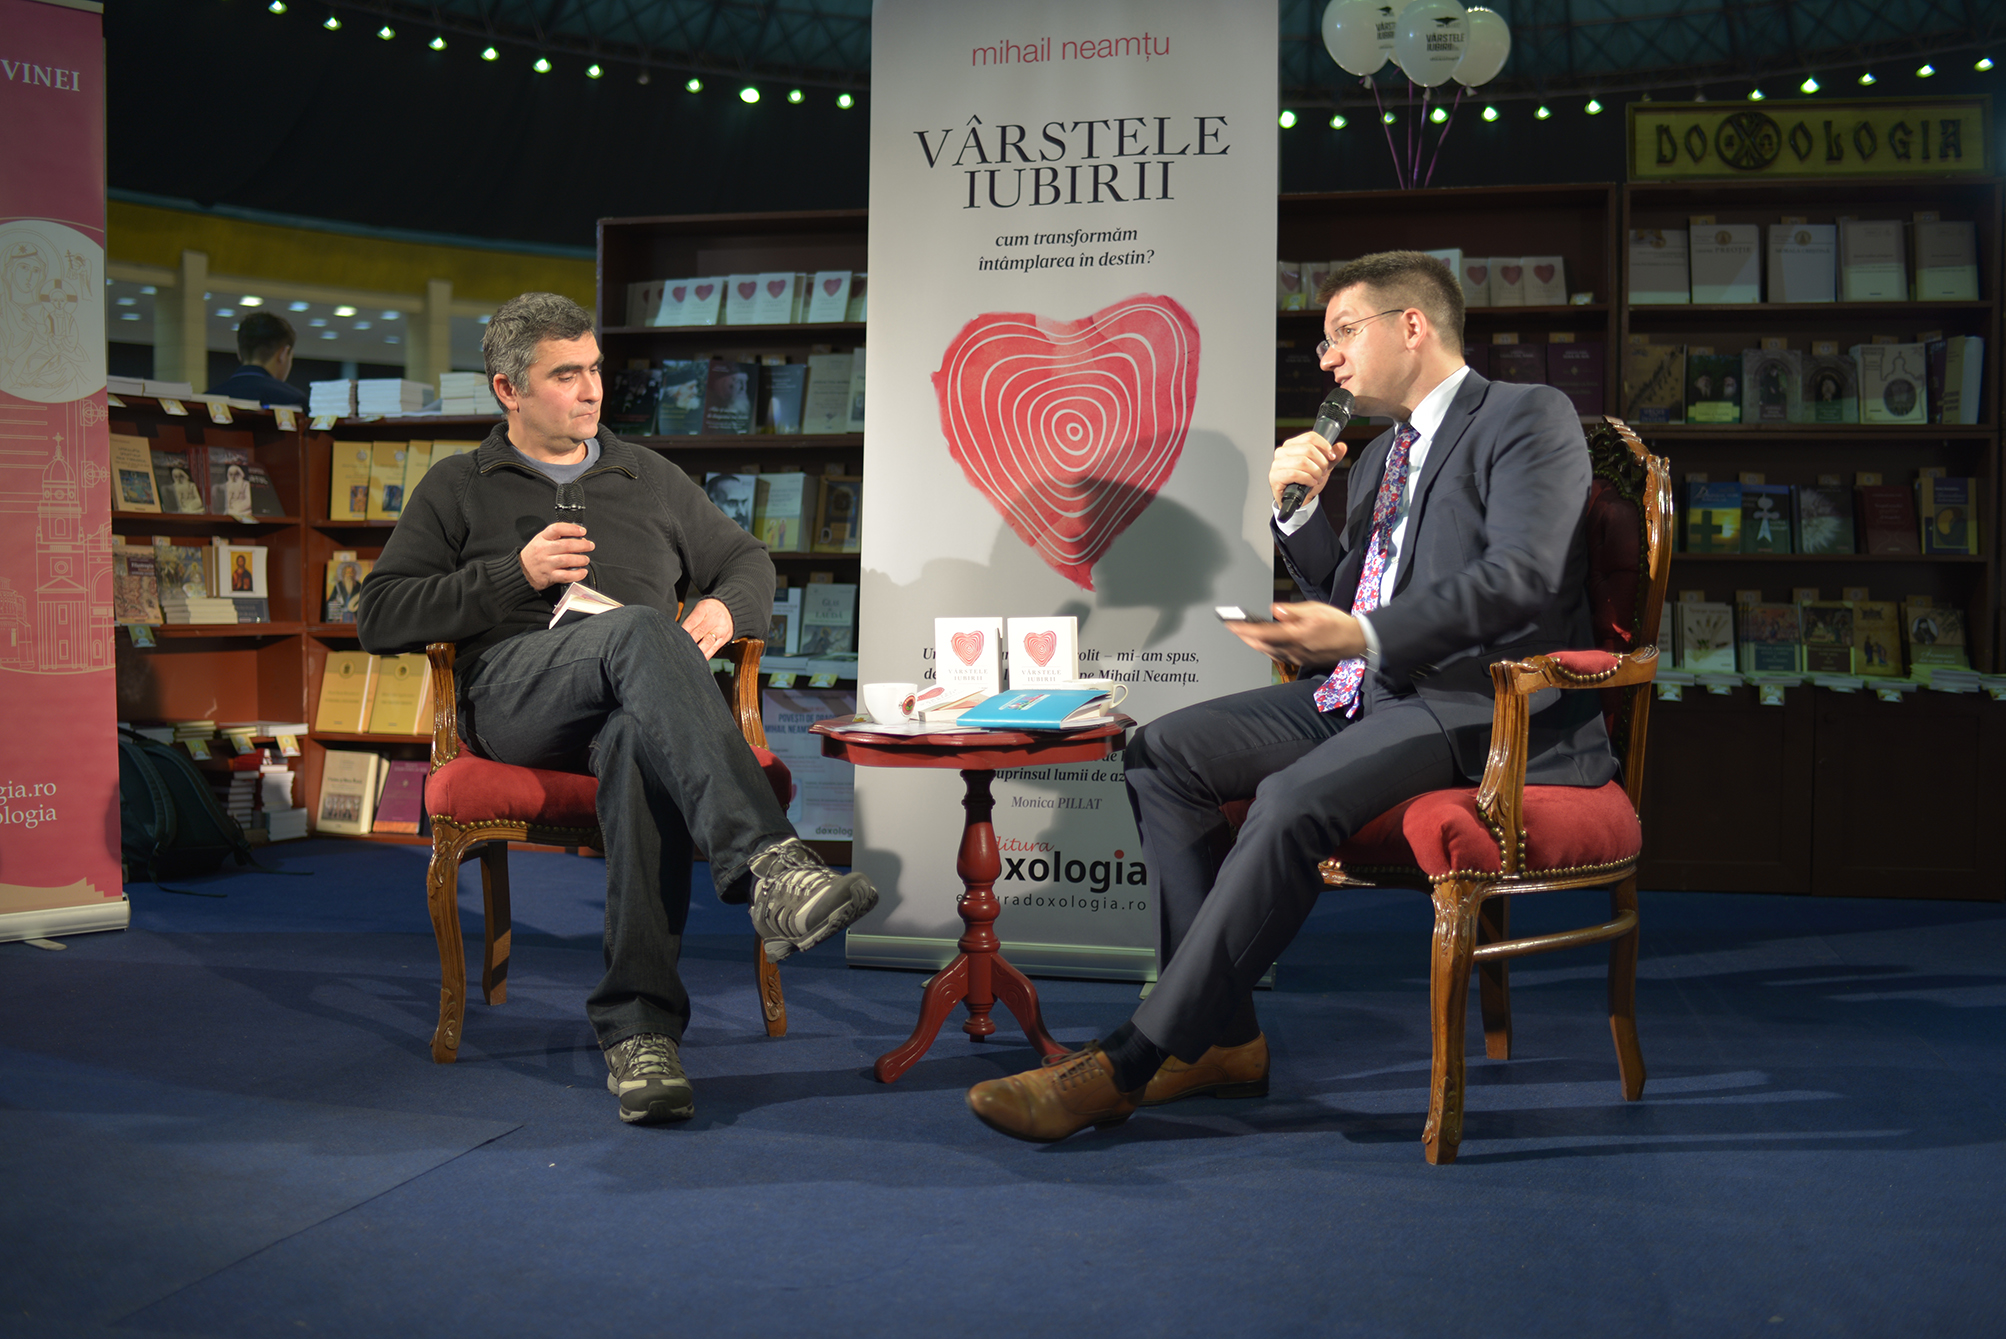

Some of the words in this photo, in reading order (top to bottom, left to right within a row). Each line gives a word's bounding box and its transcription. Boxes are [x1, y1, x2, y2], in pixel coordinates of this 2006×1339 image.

[972, 37, 1051, 66] mihail
[1062, 32, 1171, 62] neamțu
[0, 59, 80, 92] VINEI
[913, 114, 1231, 169] VÂRSTELE
[1656, 111, 1962, 170] DOXOLOGIA
[963, 161, 1174, 209] IUBIRII
[995, 233, 1030, 247] cum
[1033, 227, 1138, 247] transformăm
[978, 253, 1075, 274] întâmplarea
[1079, 253, 1095, 267] în
[1098, 249, 1155, 267] destin?
[1078, 649, 1100, 662] olit
[1117, 649, 1163, 662] mi-am
[1166, 651, 1199, 665] spus,
[1098, 669, 1141, 682] Mihail
[1143, 670, 1199, 687] Neamțu.
[765, 724, 786, 733] MIHAIL
[806, 714, 814, 722] DE
[995, 767, 1051, 783] uprinsul
[1054, 768, 1088, 782] lumii
[1091, 769, 1107, 782] de
[1011, 796, 1055, 809] Monica
[1057, 797, 1103, 810] PILLAT
[0, 804, 58, 829] logia
[815, 826, 852, 837] doxolog
[1000, 849, 1148, 894] xologia
